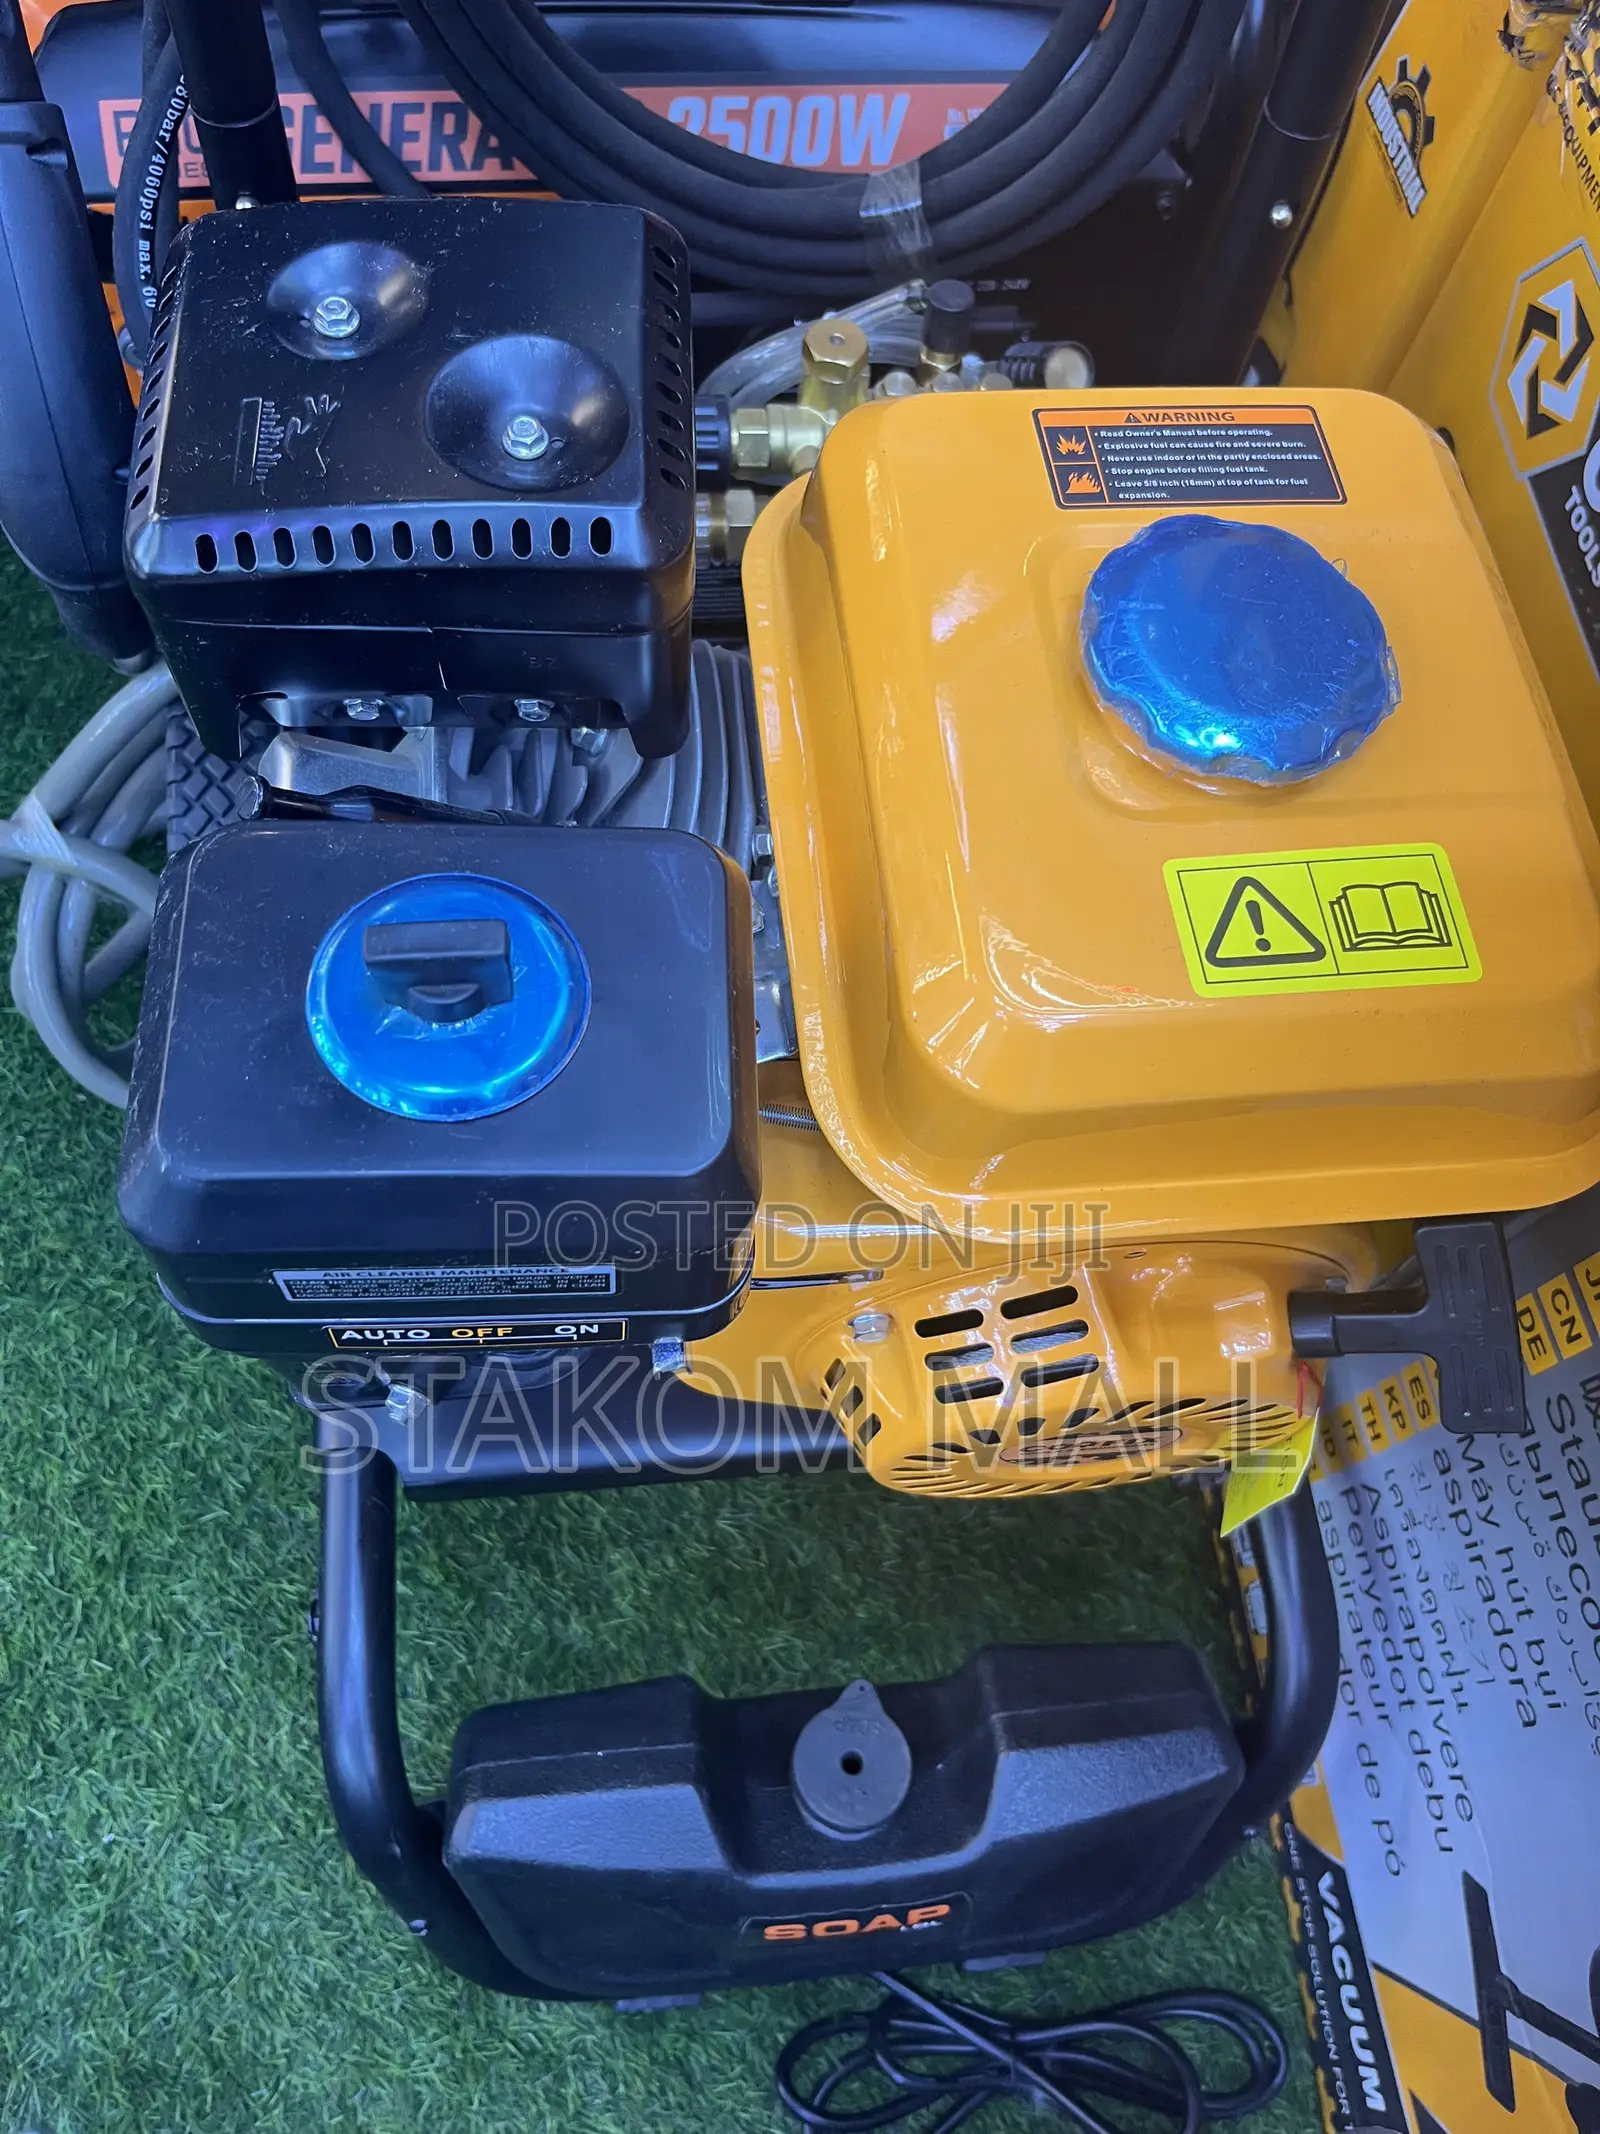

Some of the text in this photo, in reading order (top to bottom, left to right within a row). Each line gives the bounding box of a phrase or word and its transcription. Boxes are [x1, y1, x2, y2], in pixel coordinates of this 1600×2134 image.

[139, 74, 188, 232] 80bar/4060psi
[138, 239, 152, 280] max.
[1100, 430, 1124, 438] Read
[1227, 429, 1274, 437] operating.
[1141, 412, 1236, 423] WARNING
[1103, 443, 1149, 451] Explosive
[1223, 453, 1250, 462] partly
[1114, 480, 1142, 488] Leave
[1159, 479, 1180, 487] inch
[1181, 479, 1215, 488] (16mm)
[1226, 479, 1243, 487] top
[1243, 478, 1254, 486] of
[1134, 467, 1166, 475] engine
[1166, 466, 1197, 474] before
[1197, 466, 1225, 474] filling
[1118, 492, 1170, 500] expansion.
[440, 1267, 569, 1276] MAINTENANCE
[341, 1323, 600, 1341] AUTO OFF ON
[1516, 1305, 1548, 1361] DE
[1550, 1287, 1583, 1345] CN
[1360, 1396, 1382, 1443] TH
[1383, 1384, 1408, 1430] KP
[1405, 1375, 1431, 1420] ES
[1433, 1448, 1538, 1729] aspiradora
[1455, 1433, 1568, 1710] Máy hút bụi
[1317, 1500, 1394, 1729] aspirateur
[1340, 1486, 1454, 1853] Penyedot debu
[1360, 1483, 1474, 1823] Aspirapolvere
[1356, 1742, 1382, 1800] de
[1370, 1818, 1407, 1877] pó
[763, 1903, 951, 1941] SOAP
[1284, 1822, 1301, 1871] ONE
[1296, 1877, 1316, 1938] STOP
[1308, 1943, 1340, 2061] SOLUTION
[1332, 2066, 1350, 2115] FOR
[1317, 1870, 1387, 2113] VACUUM
